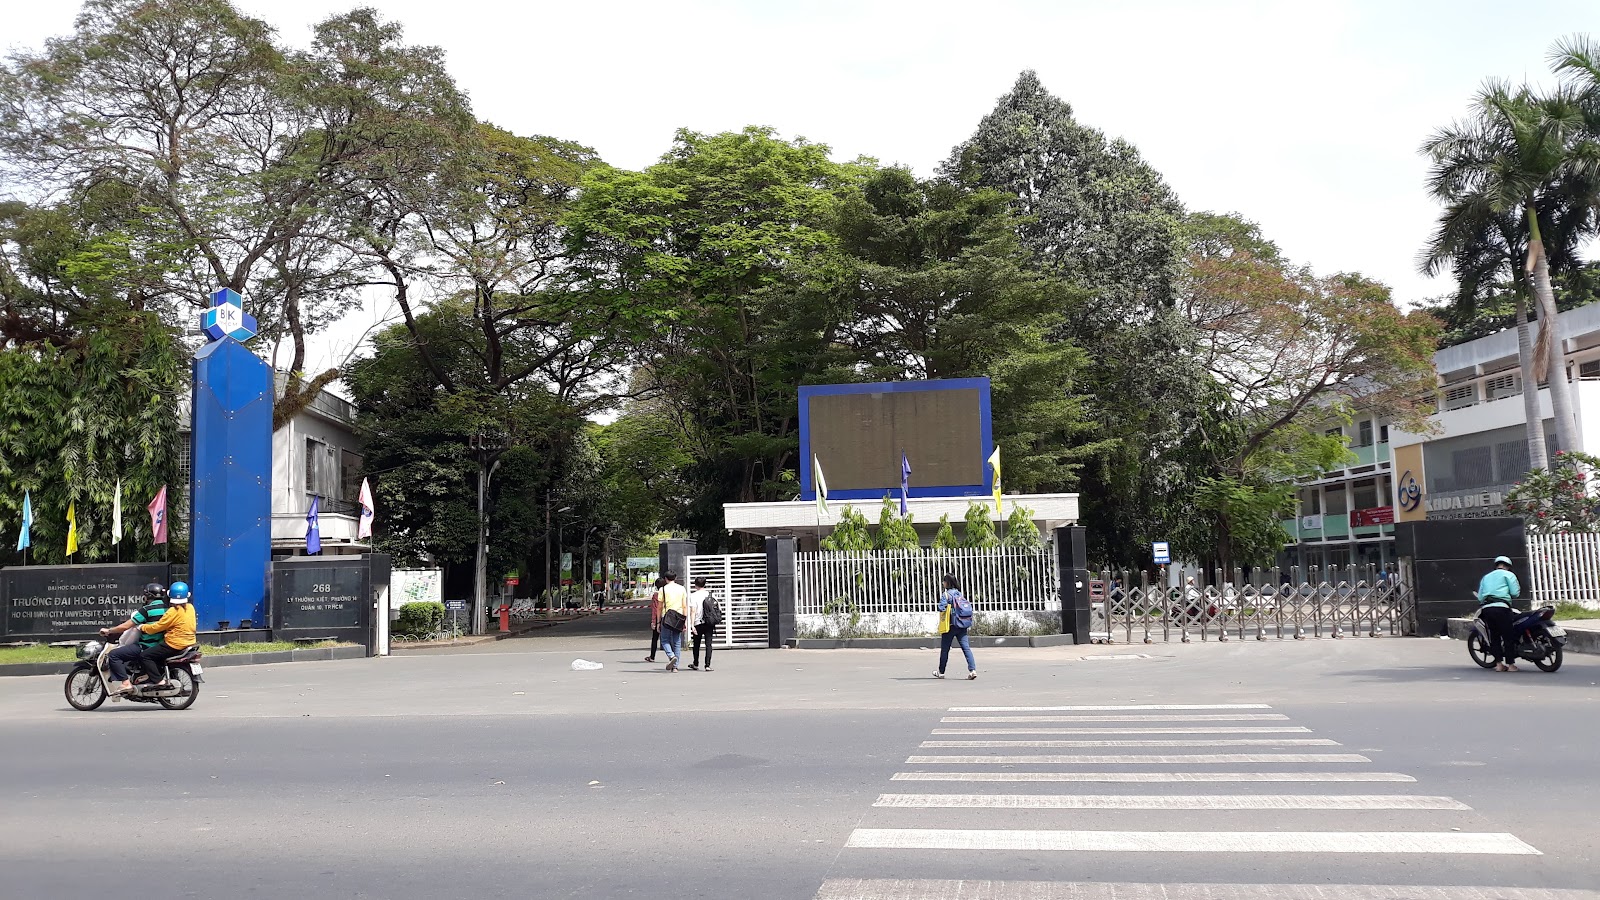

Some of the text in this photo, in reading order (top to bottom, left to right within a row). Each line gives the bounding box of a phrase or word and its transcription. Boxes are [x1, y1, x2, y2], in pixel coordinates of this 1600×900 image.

[220, 308, 235, 320] BK
[1425, 497, 1460, 512] KHOA
[312, 584, 330, 592] 268
[49, 610, 64, 618] CITY
[65, 608, 101, 618] UNIVERSITY
[102, 609, 112, 617] OF
